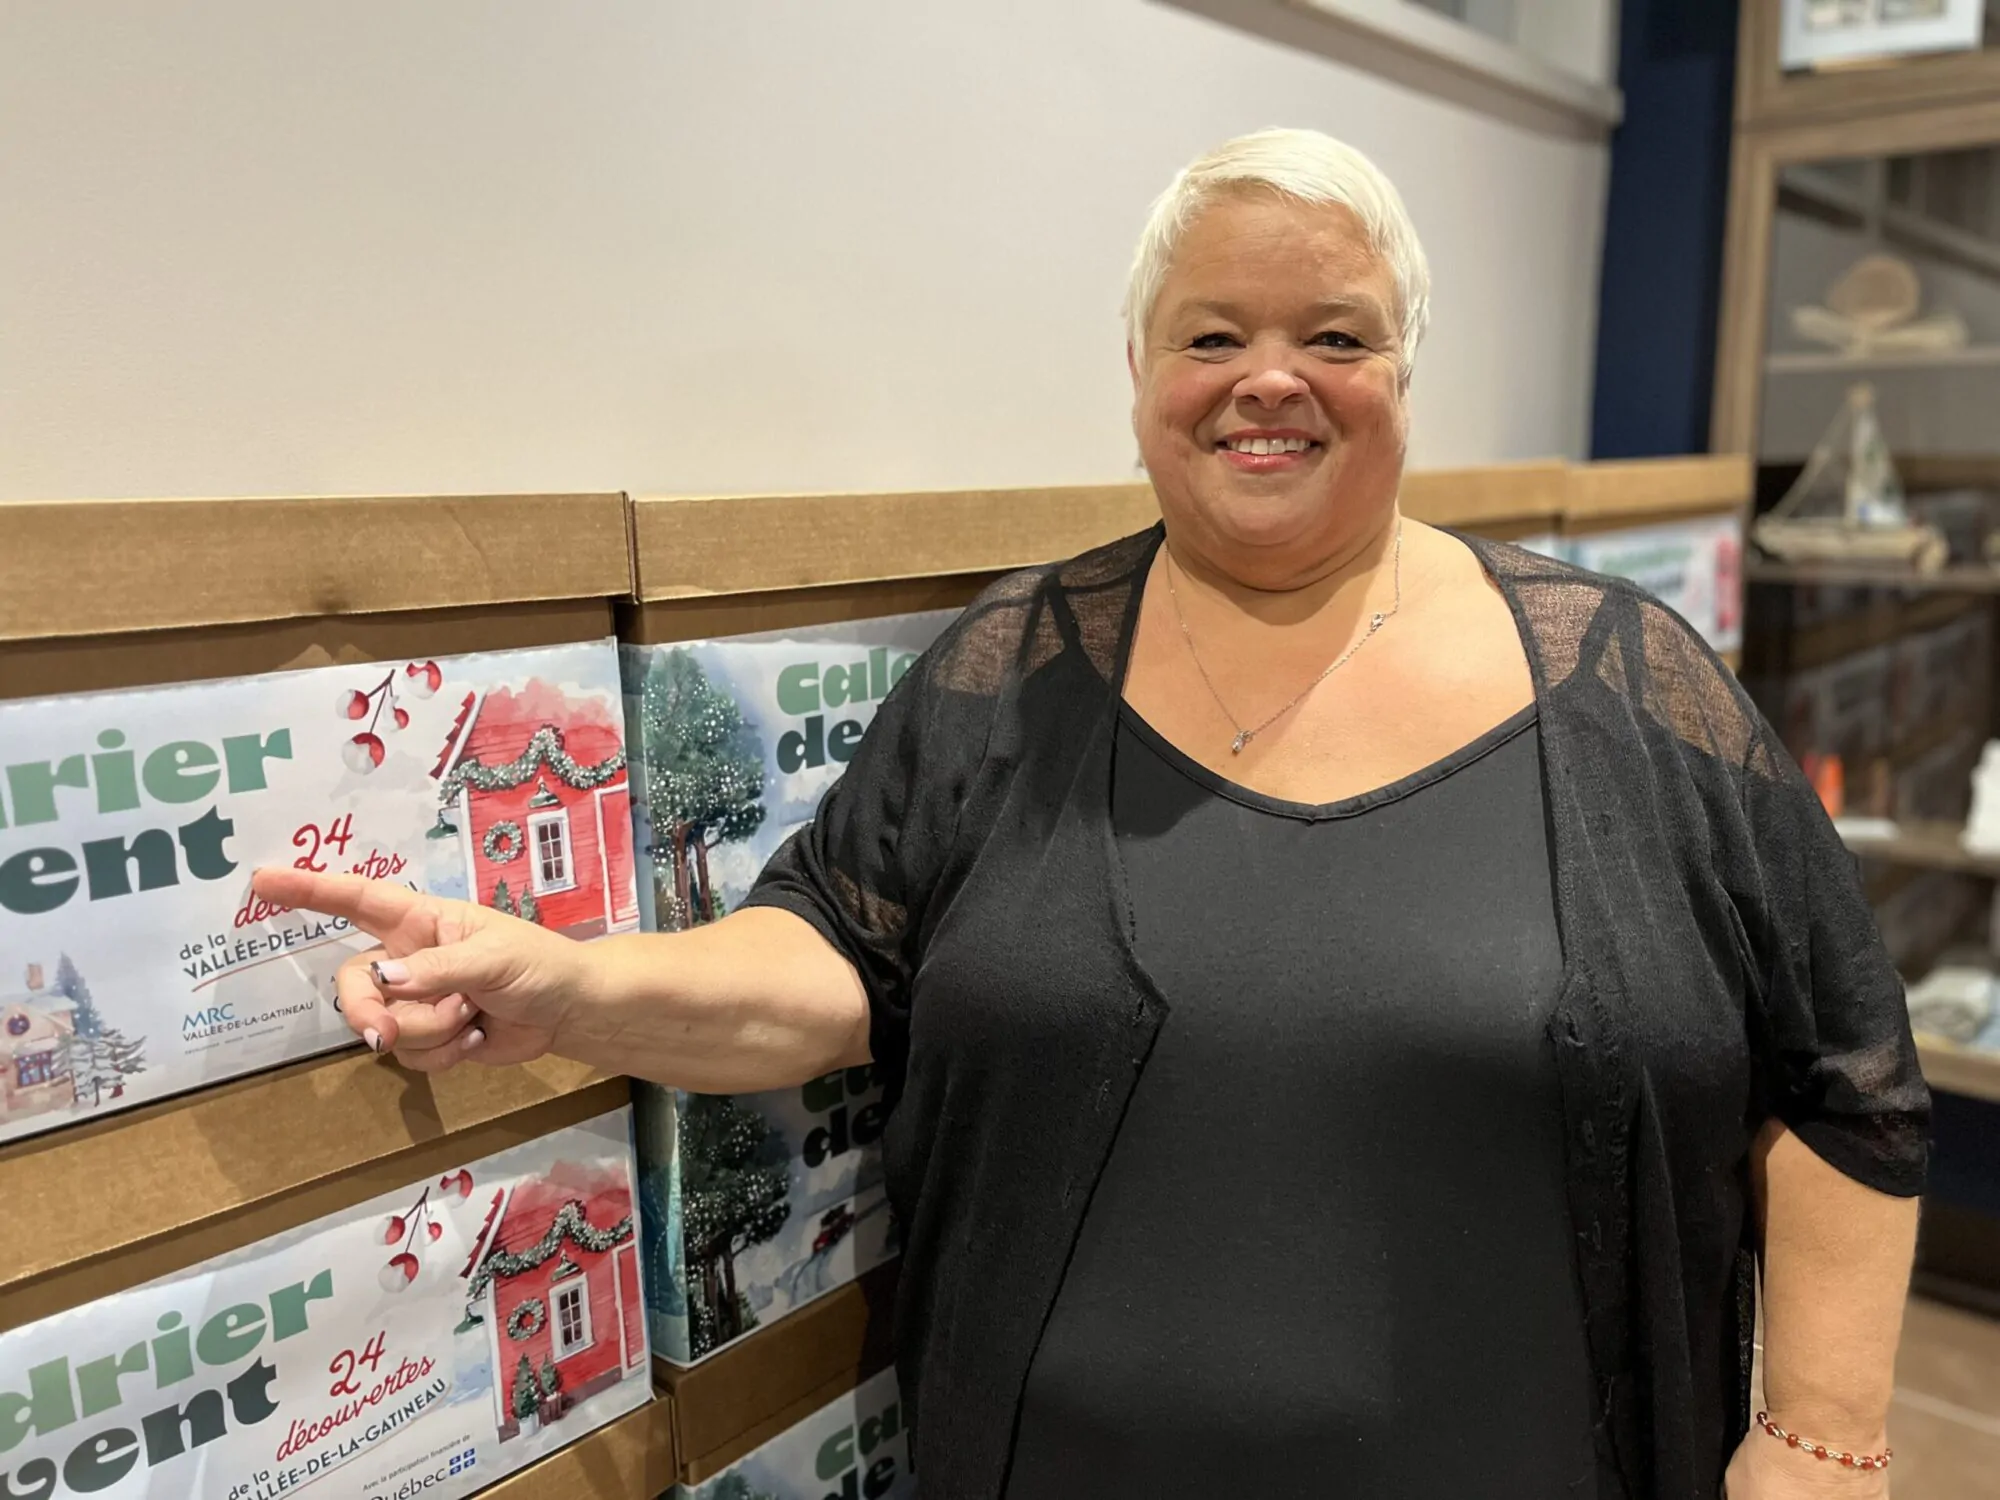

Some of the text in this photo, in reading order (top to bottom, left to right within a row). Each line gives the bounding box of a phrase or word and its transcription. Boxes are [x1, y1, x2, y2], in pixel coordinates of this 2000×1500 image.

[777, 715, 863, 774] de
[0, 728, 292, 829] rier
[293, 813, 353, 873] 24
[180, 933, 226, 960] de la
[182, 1003, 236, 1031] MRC
[803, 1104, 883, 1168] de
[329, 1330, 386, 1397] 24
[276, 1356, 436, 1462] découvertes
[228, 1469, 270, 1500] de la
